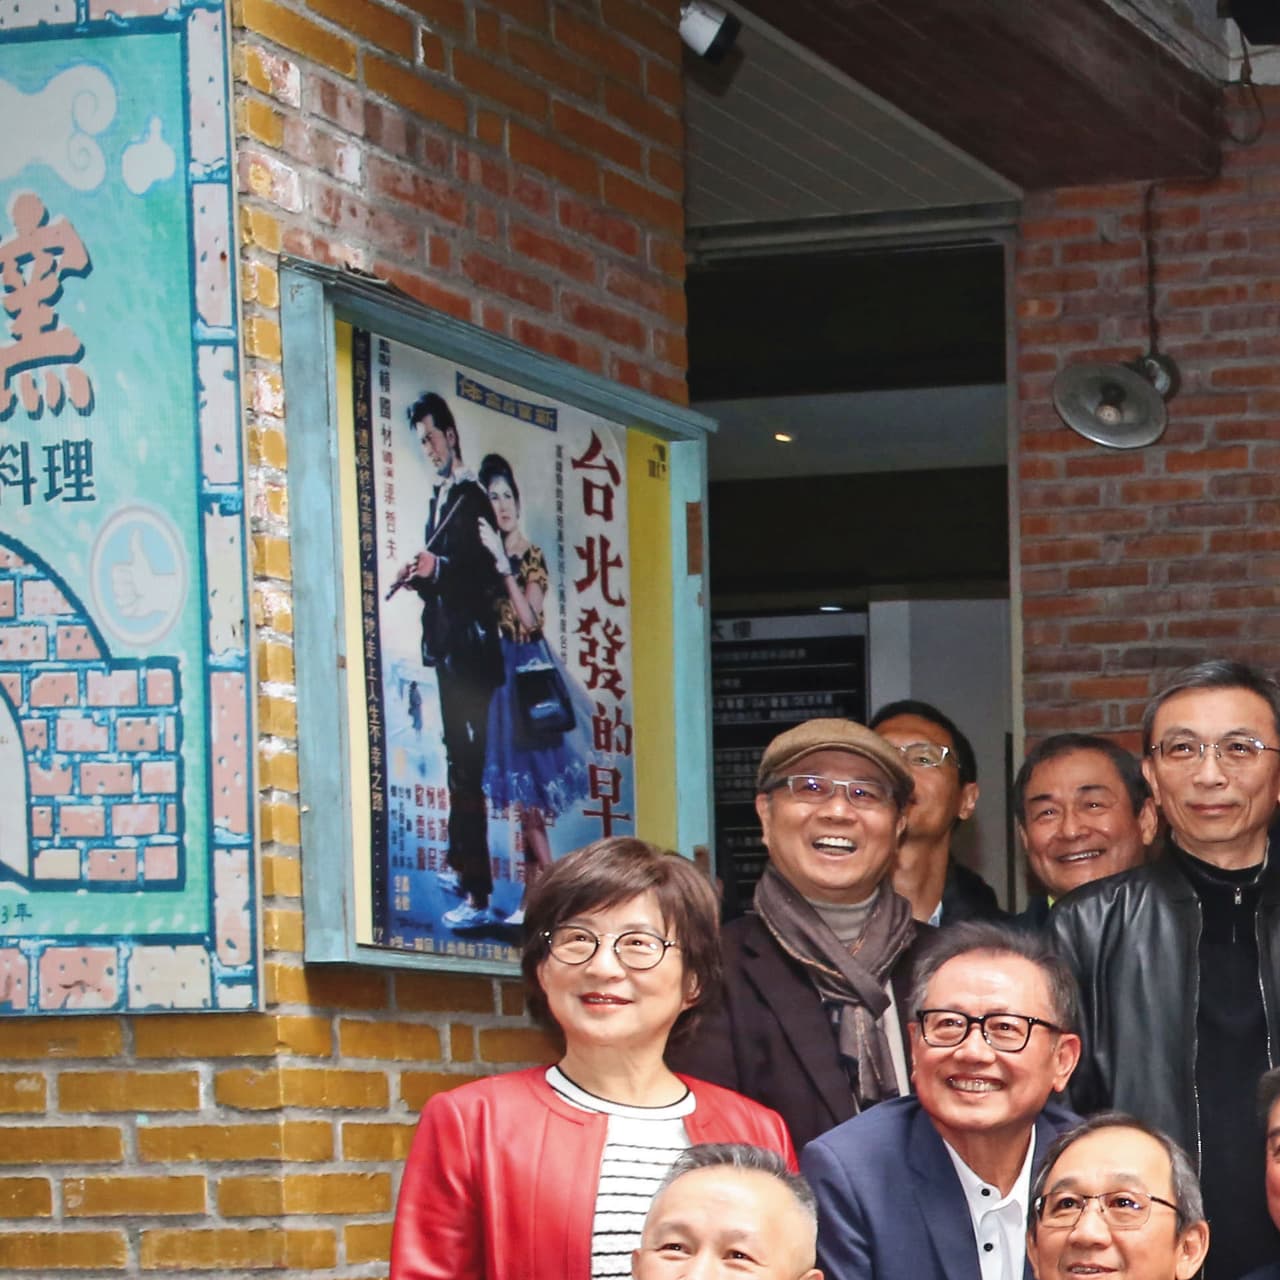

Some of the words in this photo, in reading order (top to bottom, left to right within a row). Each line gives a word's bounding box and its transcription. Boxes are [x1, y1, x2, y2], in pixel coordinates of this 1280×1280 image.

[0, 438, 96, 505] 料理
[570, 428, 634, 838] 台北發的早
